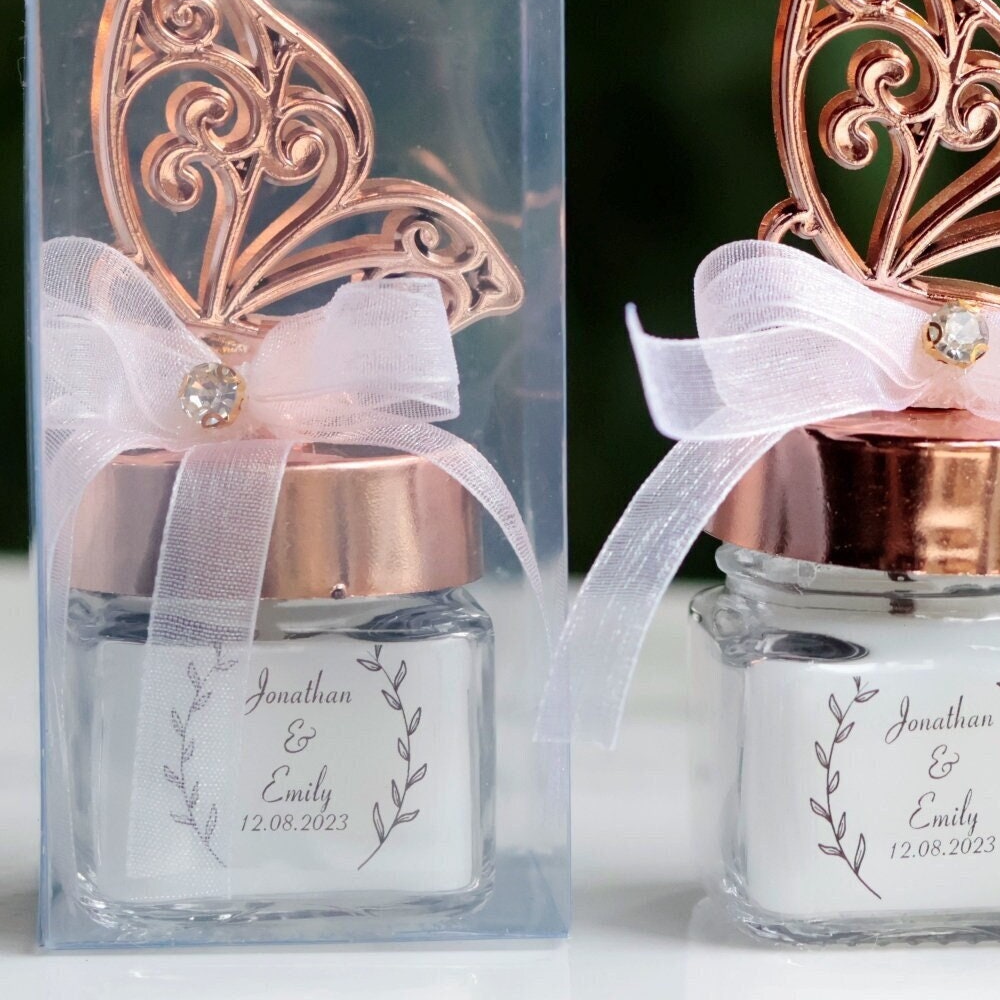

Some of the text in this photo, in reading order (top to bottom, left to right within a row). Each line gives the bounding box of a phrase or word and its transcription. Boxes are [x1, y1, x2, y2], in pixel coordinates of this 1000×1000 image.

[243, 667, 352, 716] Jonathan
[283, 718, 316, 753] &
[884, 695, 994, 744] Jonathan
[928, 744, 960, 779] &
[261, 764, 332, 813] Emily
[241, 814, 349, 832] 12.08.2023
[908, 788, 979, 836] Emily
[890, 835, 996, 860] 12.08.2023
